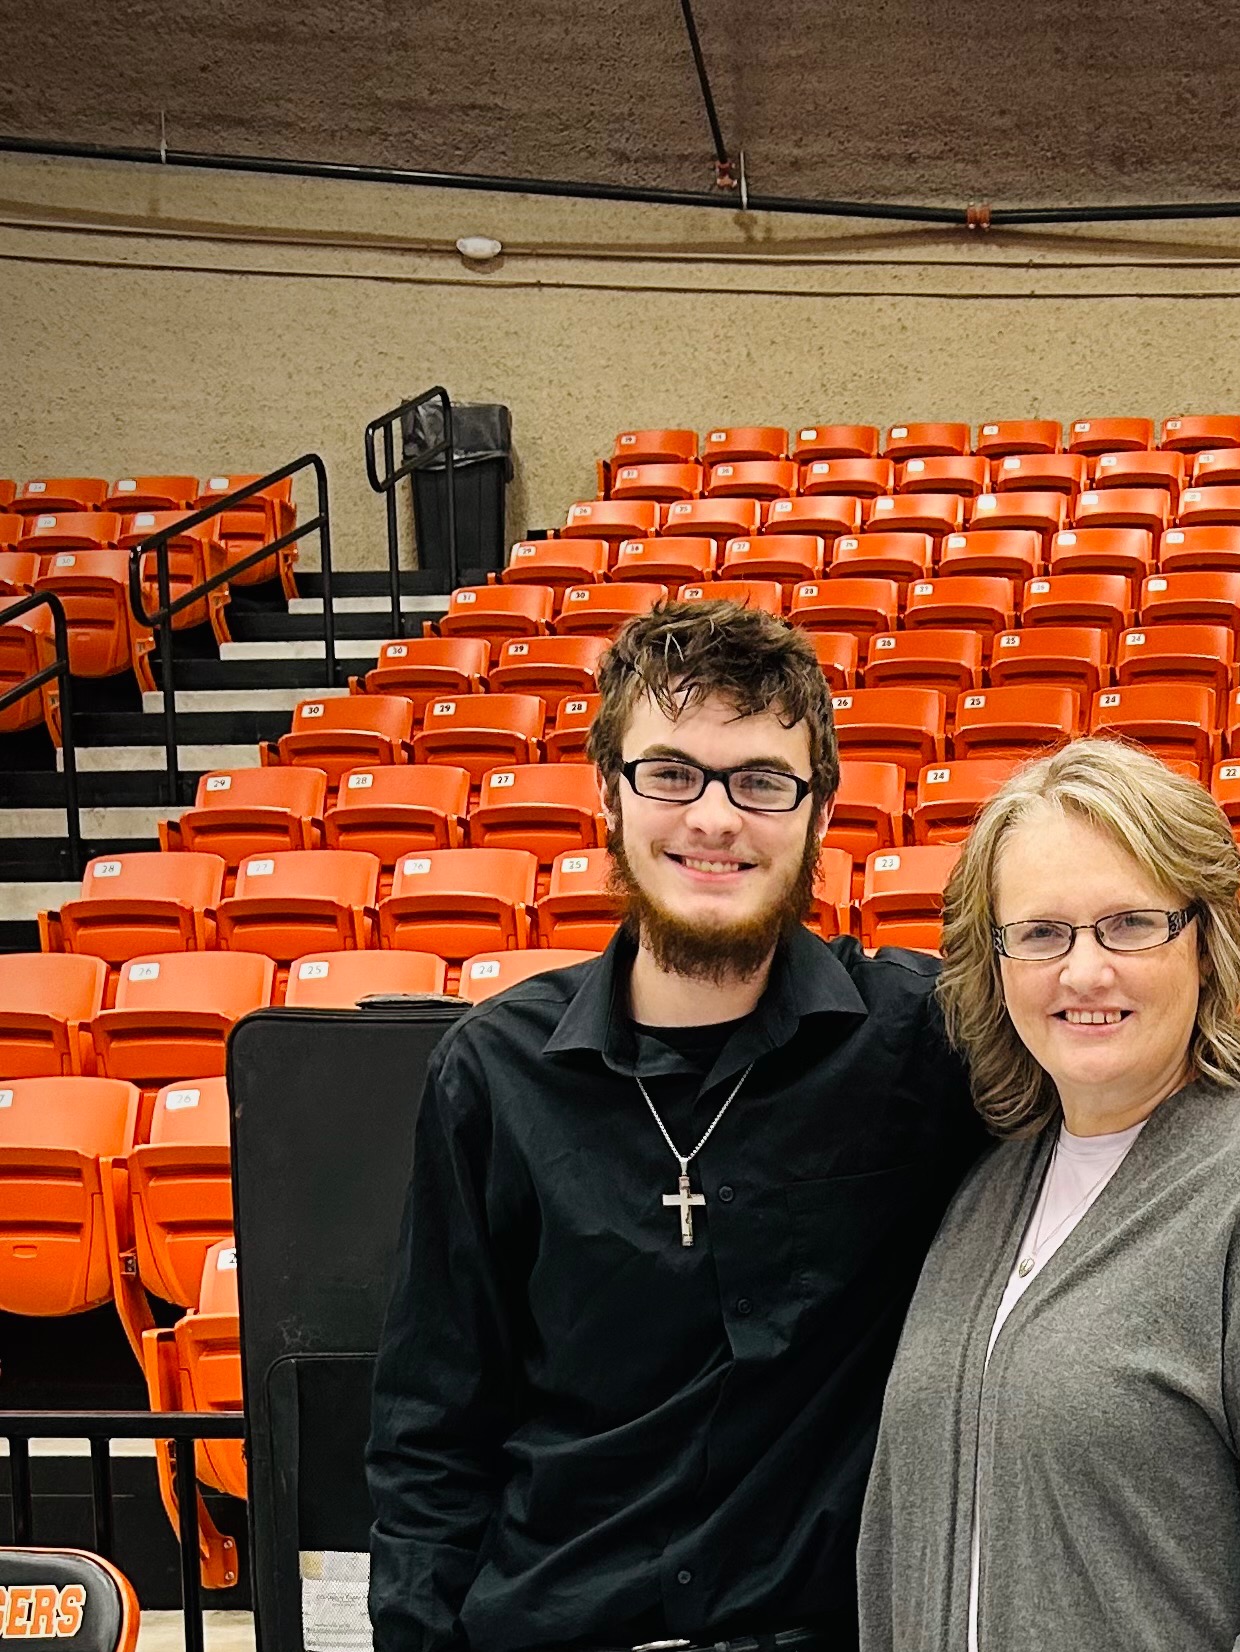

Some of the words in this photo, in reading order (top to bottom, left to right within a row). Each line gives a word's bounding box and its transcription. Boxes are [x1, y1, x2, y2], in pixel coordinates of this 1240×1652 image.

[138, 966, 152, 976] 26
[307, 965, 322, 975] 25
[479, 964, 493, 975] 24
[177, 1094, 192, 1104] 26
[0, 1585, 87, 1639] ERS
